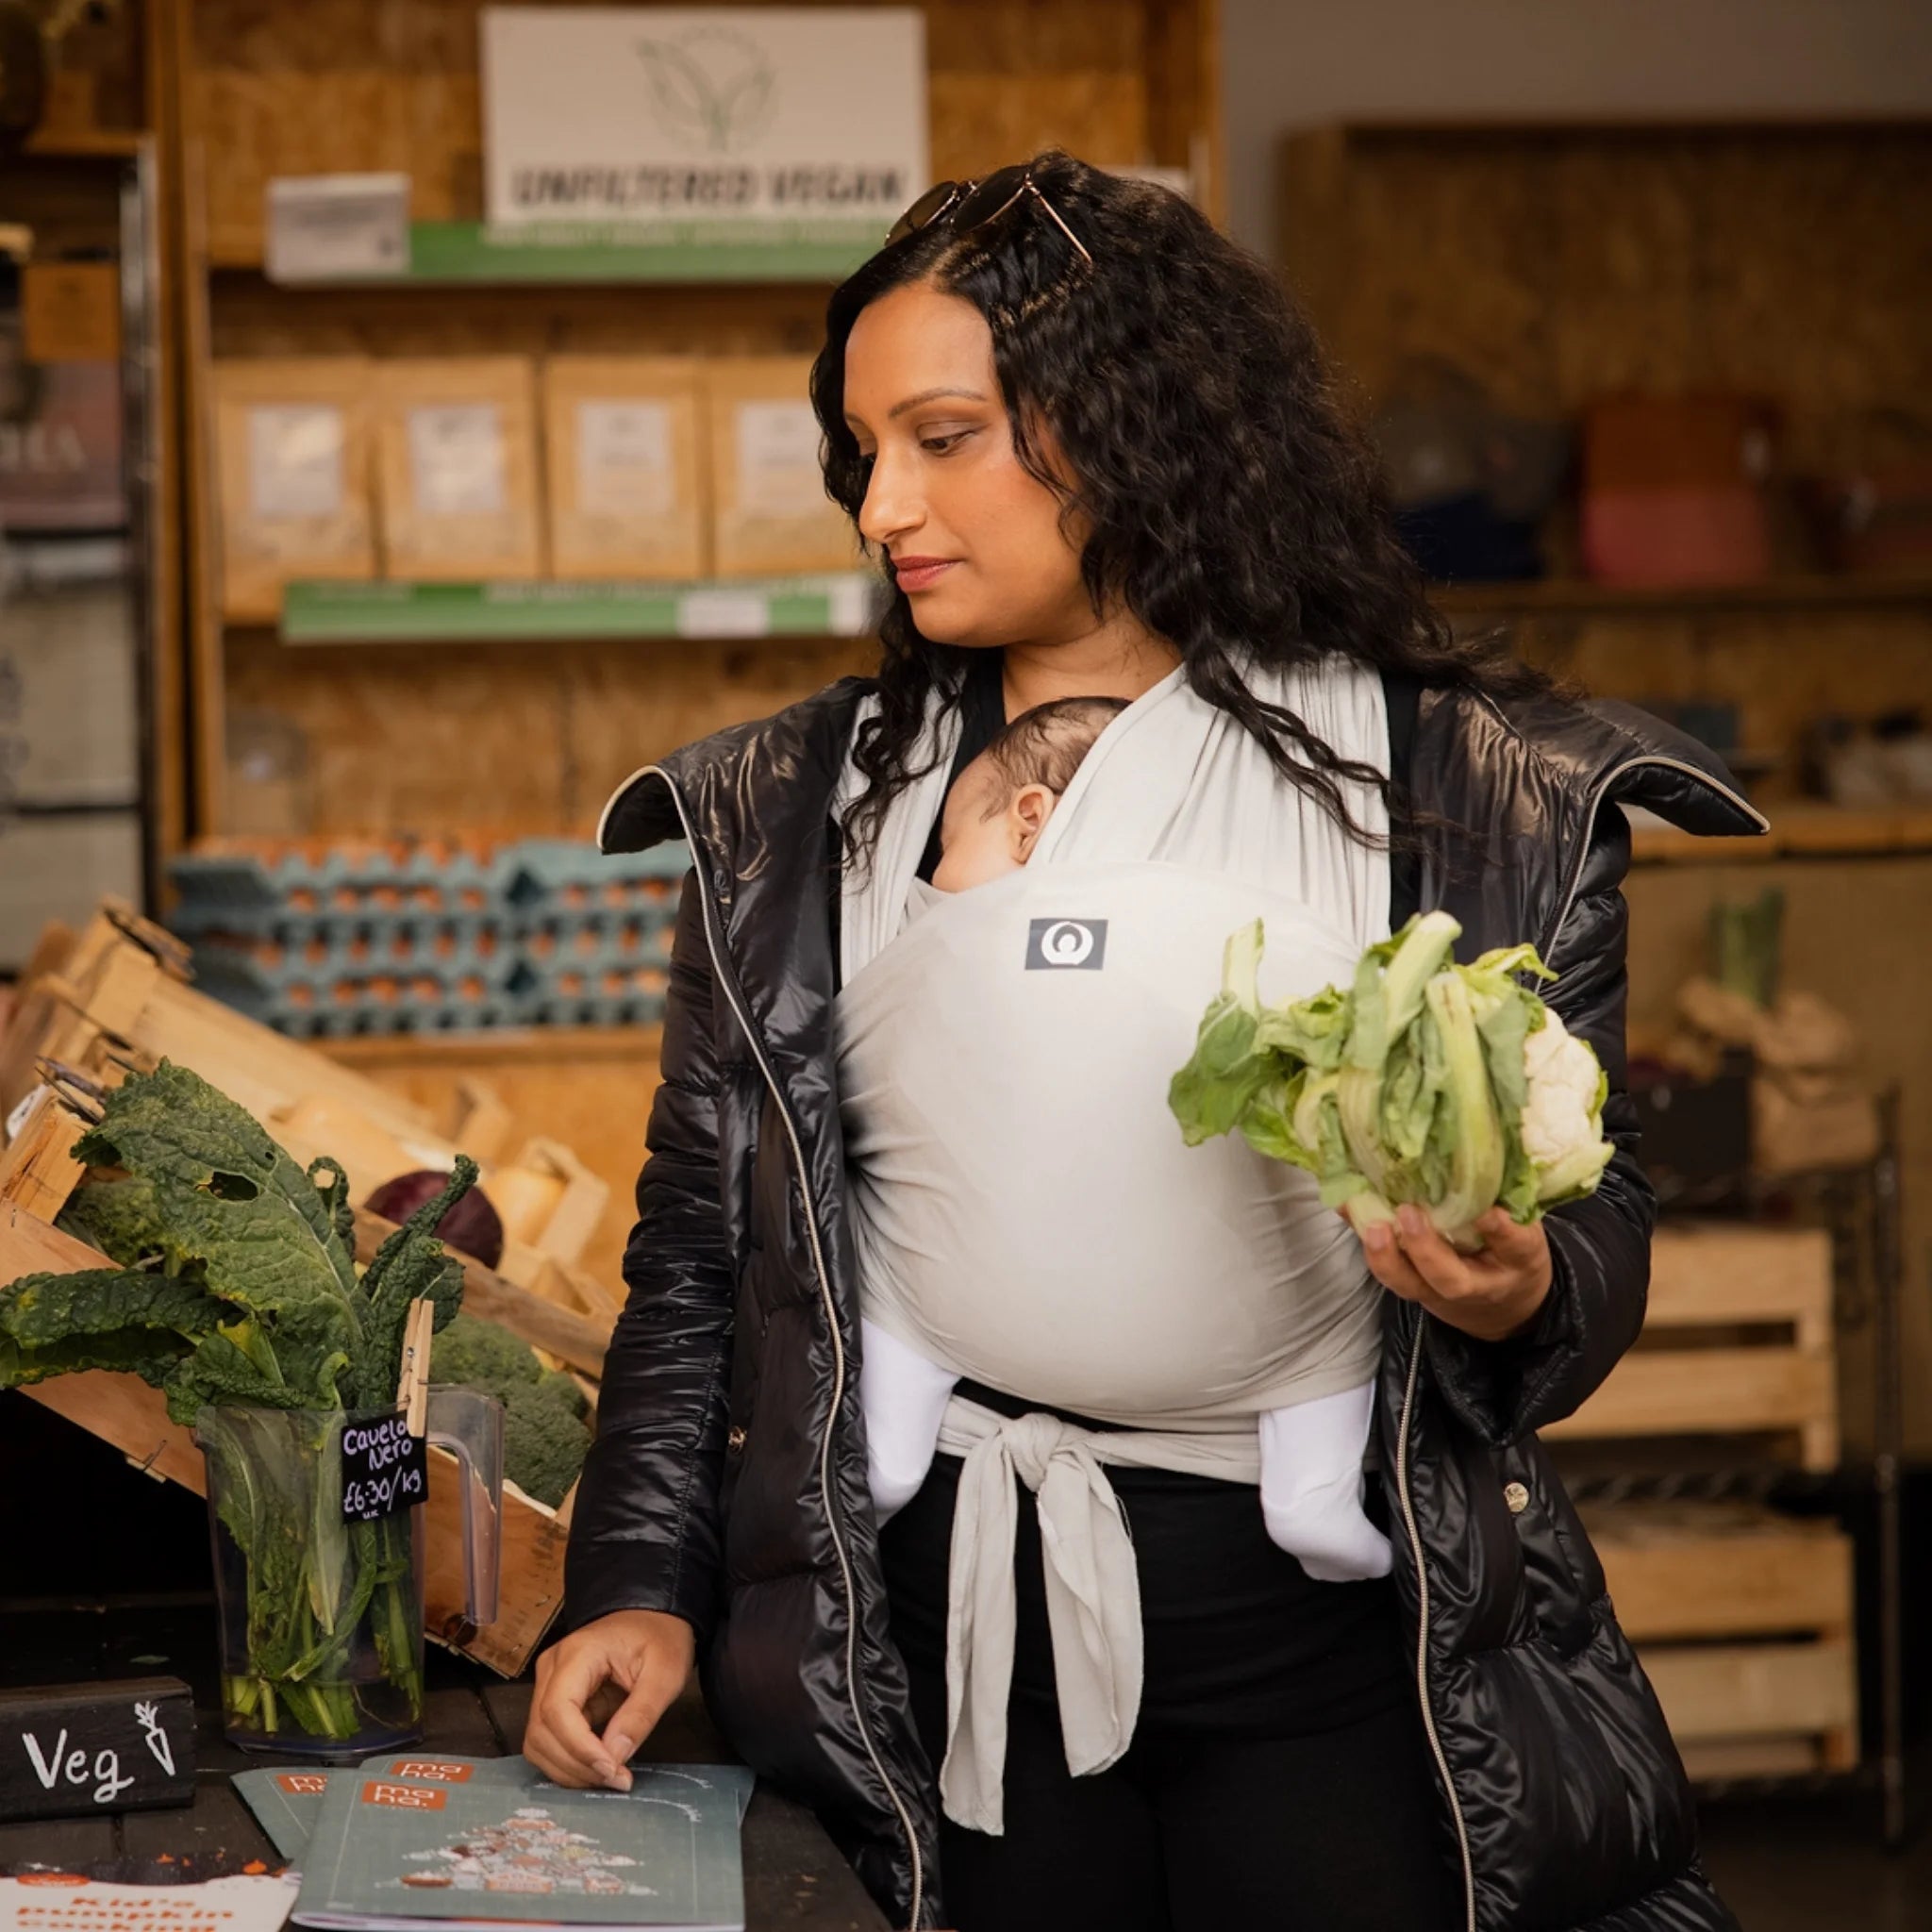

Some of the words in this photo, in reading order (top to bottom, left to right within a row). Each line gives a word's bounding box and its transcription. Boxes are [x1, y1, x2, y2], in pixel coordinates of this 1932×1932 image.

[767, 163, 907, 205] VEGAN
[368, 1438, 413, 1471] Nero
[22, 1728, 136, 1804] Veg
[71, 1895, 196, 1908] Kid's
[16, 1906, 235, 1922] pumpkin
[16, 1918, 217, 1932] cooking
